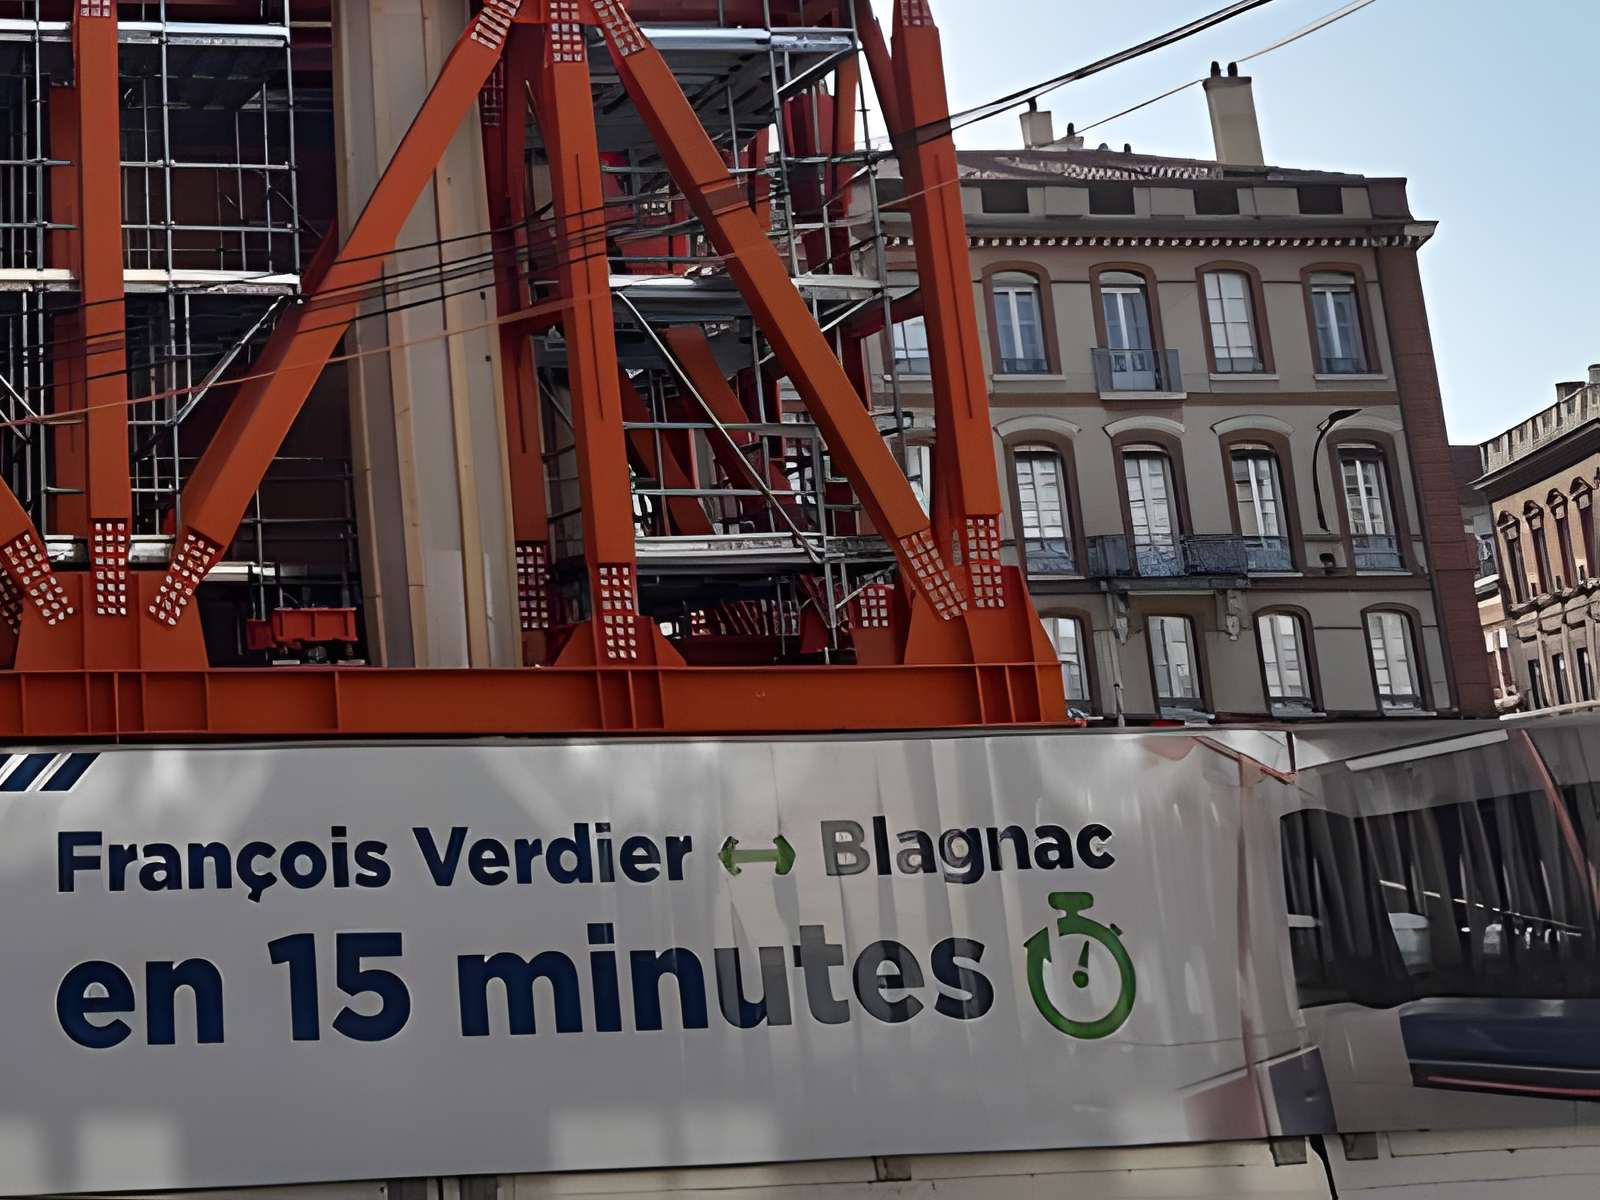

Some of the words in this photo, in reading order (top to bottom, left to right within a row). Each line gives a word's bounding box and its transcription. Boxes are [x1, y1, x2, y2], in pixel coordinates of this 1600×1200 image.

[57, 825, 393, 903] François
[412, 822, 693, 888] Verdier
[821, 815, 1115, 885] Blagnac
[56, 956, 225, 1050] en
[267, 931, 412, 1043] 15
[457, 922, 996, 1037] minutes
